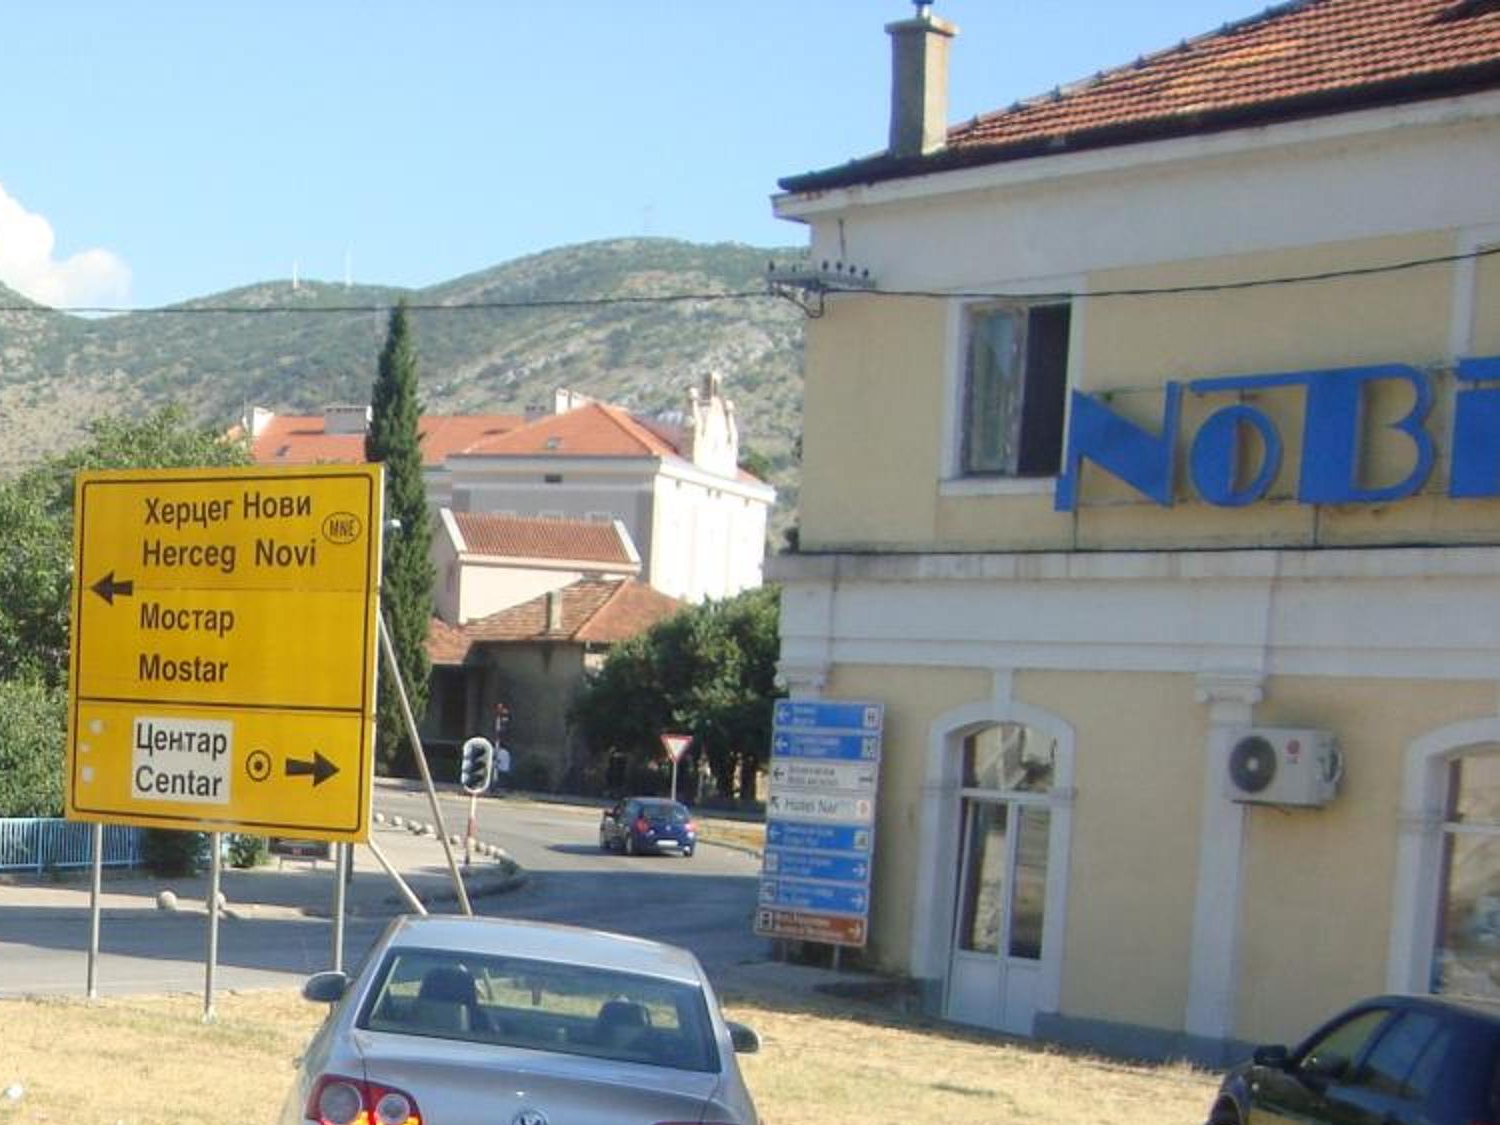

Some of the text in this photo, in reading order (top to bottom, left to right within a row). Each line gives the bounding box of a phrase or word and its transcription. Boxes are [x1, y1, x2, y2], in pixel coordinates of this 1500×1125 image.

[144, 492, 311, 530] Херцег Нови
[328, 519, 355, 538] MNE
[142, 538, 317, 573] Herceg Novi
[140, 602, 235, 638] Мостар
[138, 653, 229, 683] Mostar
[136, 722, 227, 762] Центар
[135, 764, 223, 797] Centar
